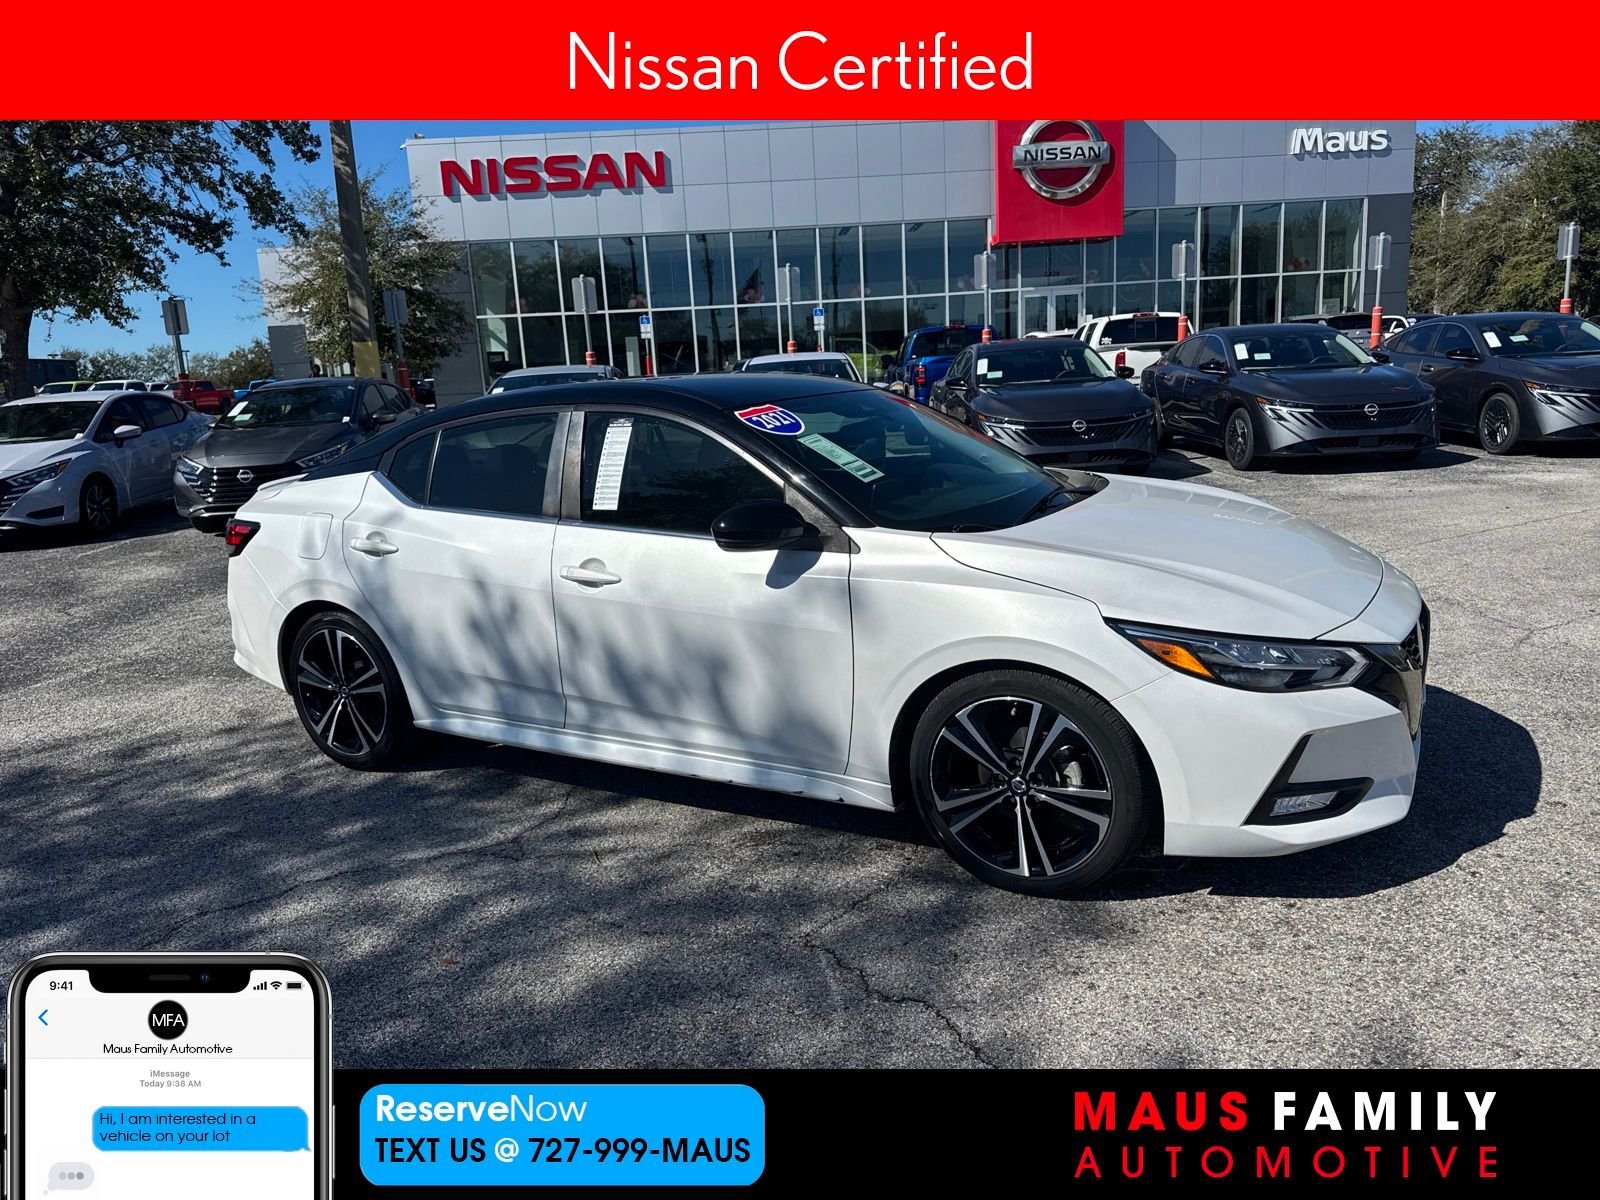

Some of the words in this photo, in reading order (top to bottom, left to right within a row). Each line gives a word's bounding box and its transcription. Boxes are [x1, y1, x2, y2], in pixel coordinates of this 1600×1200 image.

[1289, 127, 1388, 154] Maus
[1023, 146, 1101, 162] NISSAN
[440, 151, 667, 197] NISSAN
[752, 411, 796, 430] 2021
